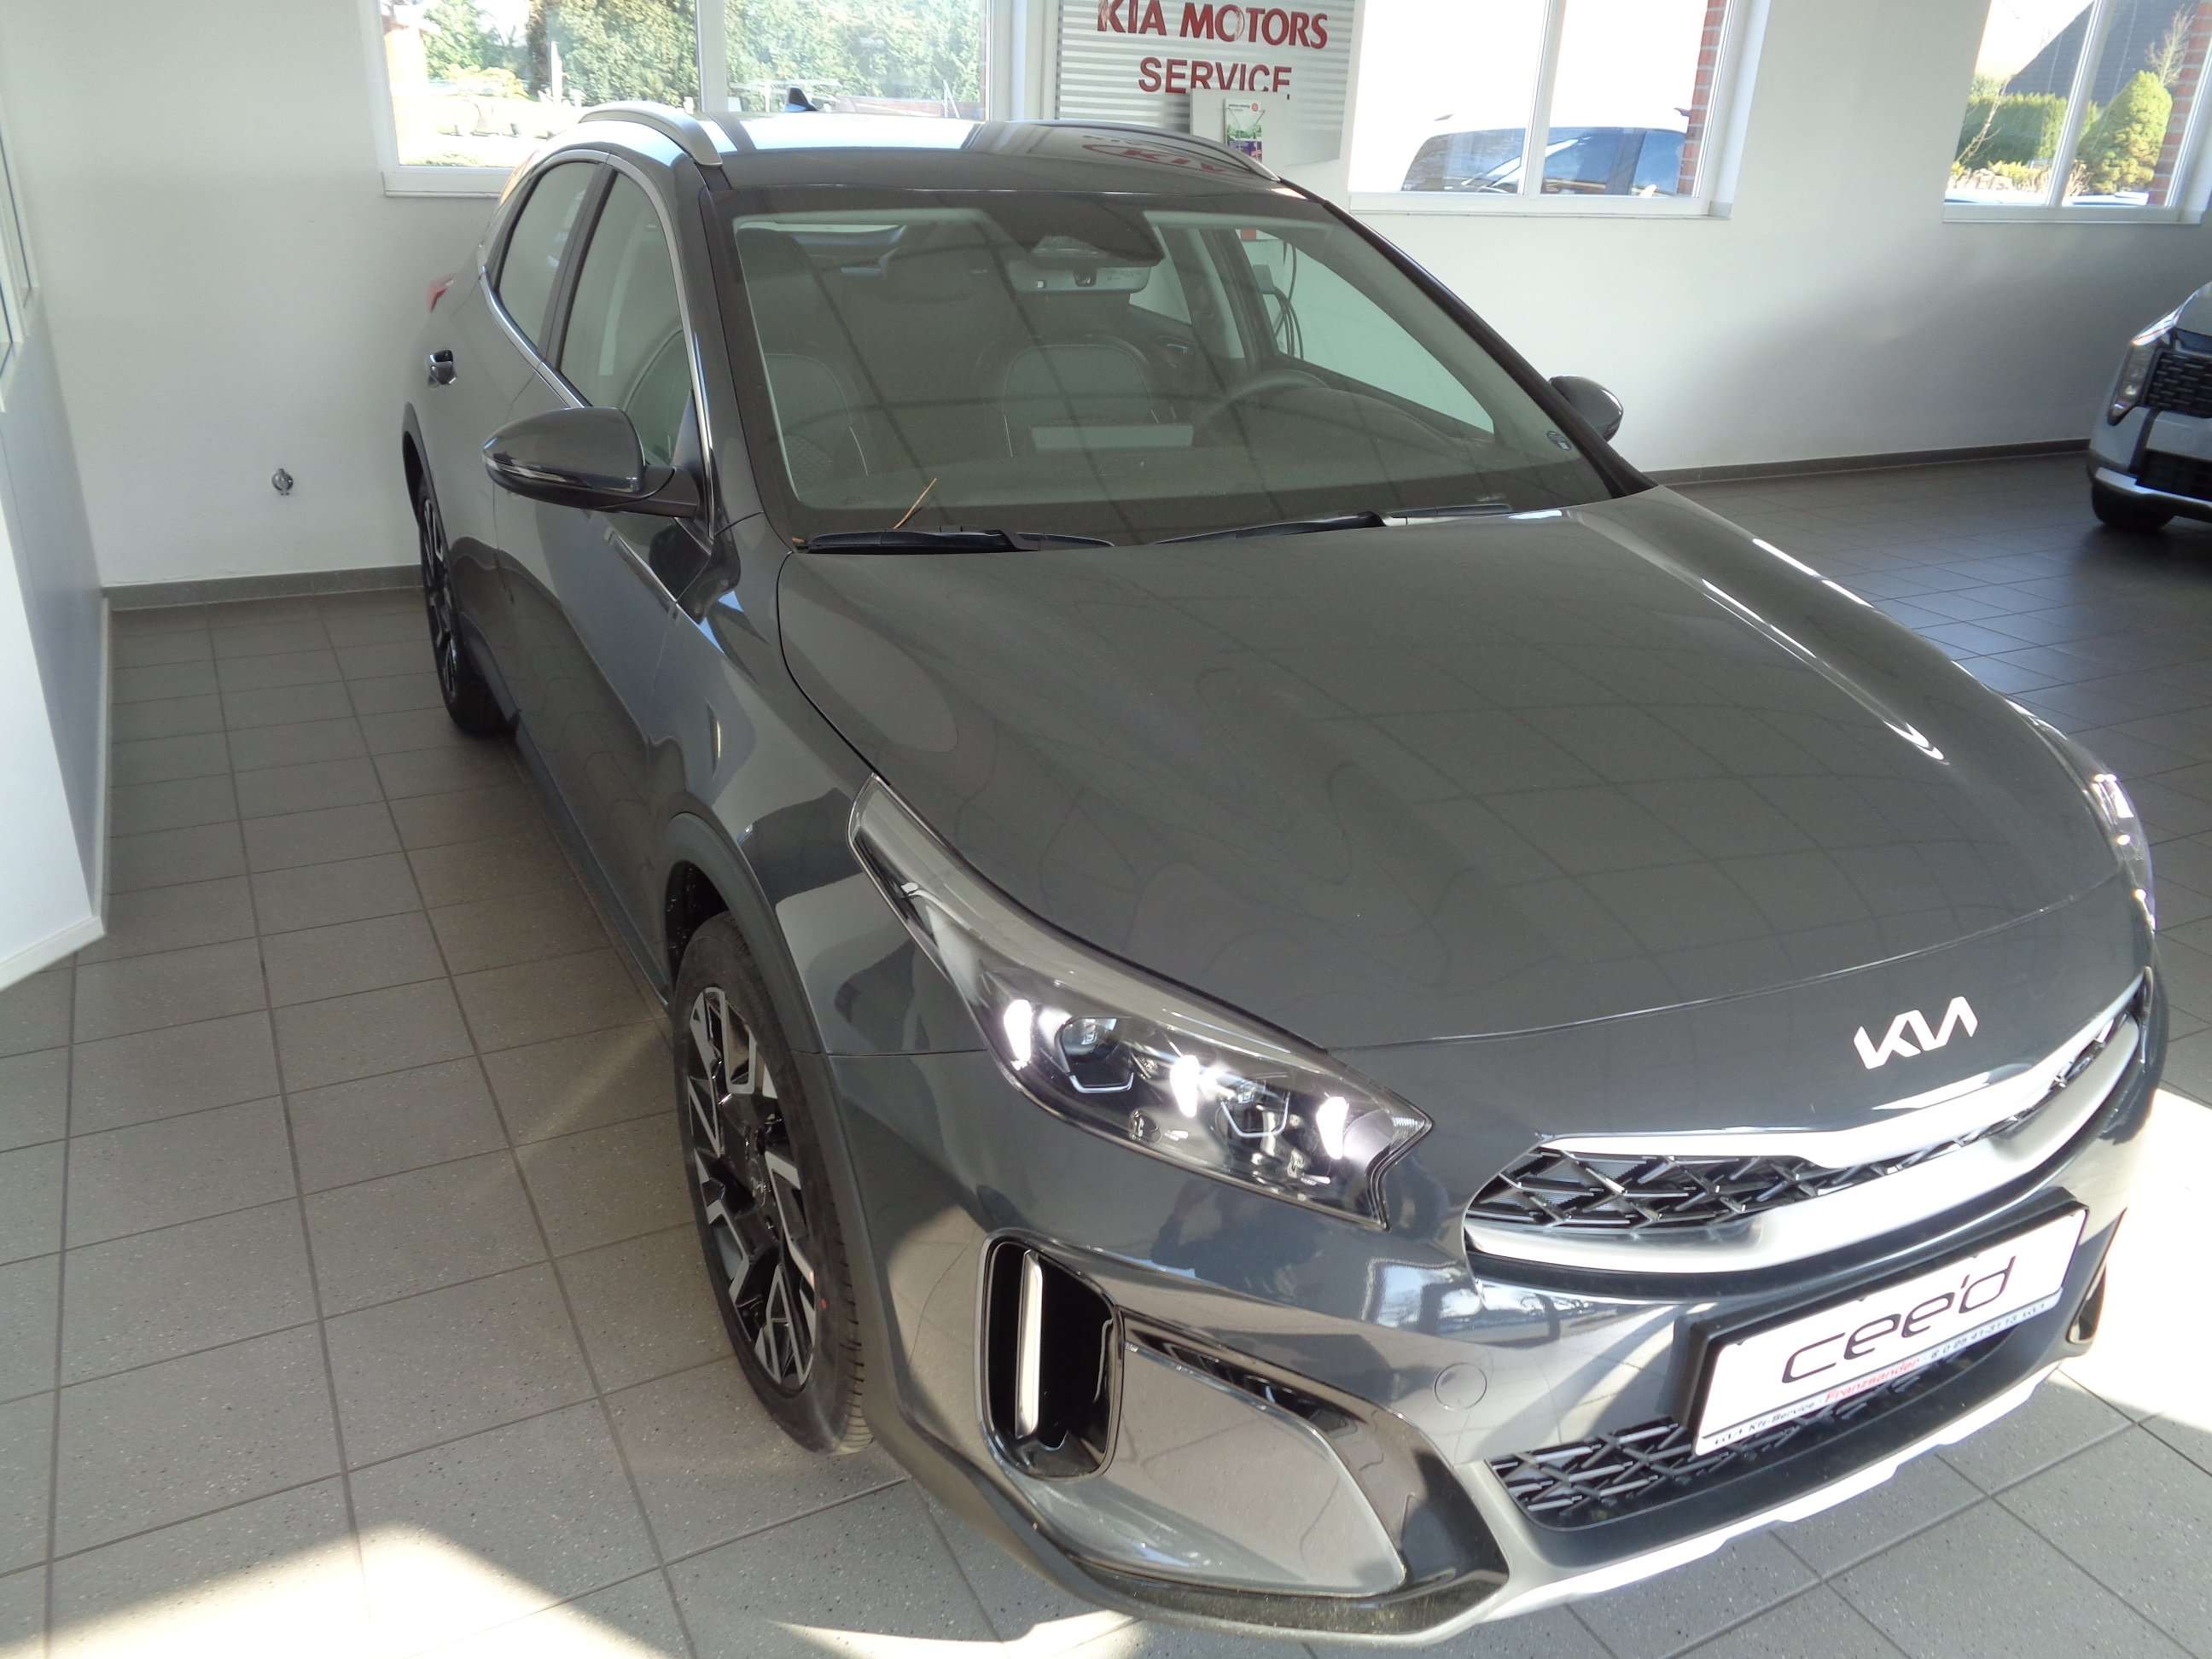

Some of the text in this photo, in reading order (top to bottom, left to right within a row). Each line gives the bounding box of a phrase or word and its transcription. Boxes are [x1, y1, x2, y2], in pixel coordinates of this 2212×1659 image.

[1097, 0, 1329, 49] KIA MOTORS
[1853, 995, 1979, 1070] KIA
[1782, 1255, 2017, 1384] cee'd
